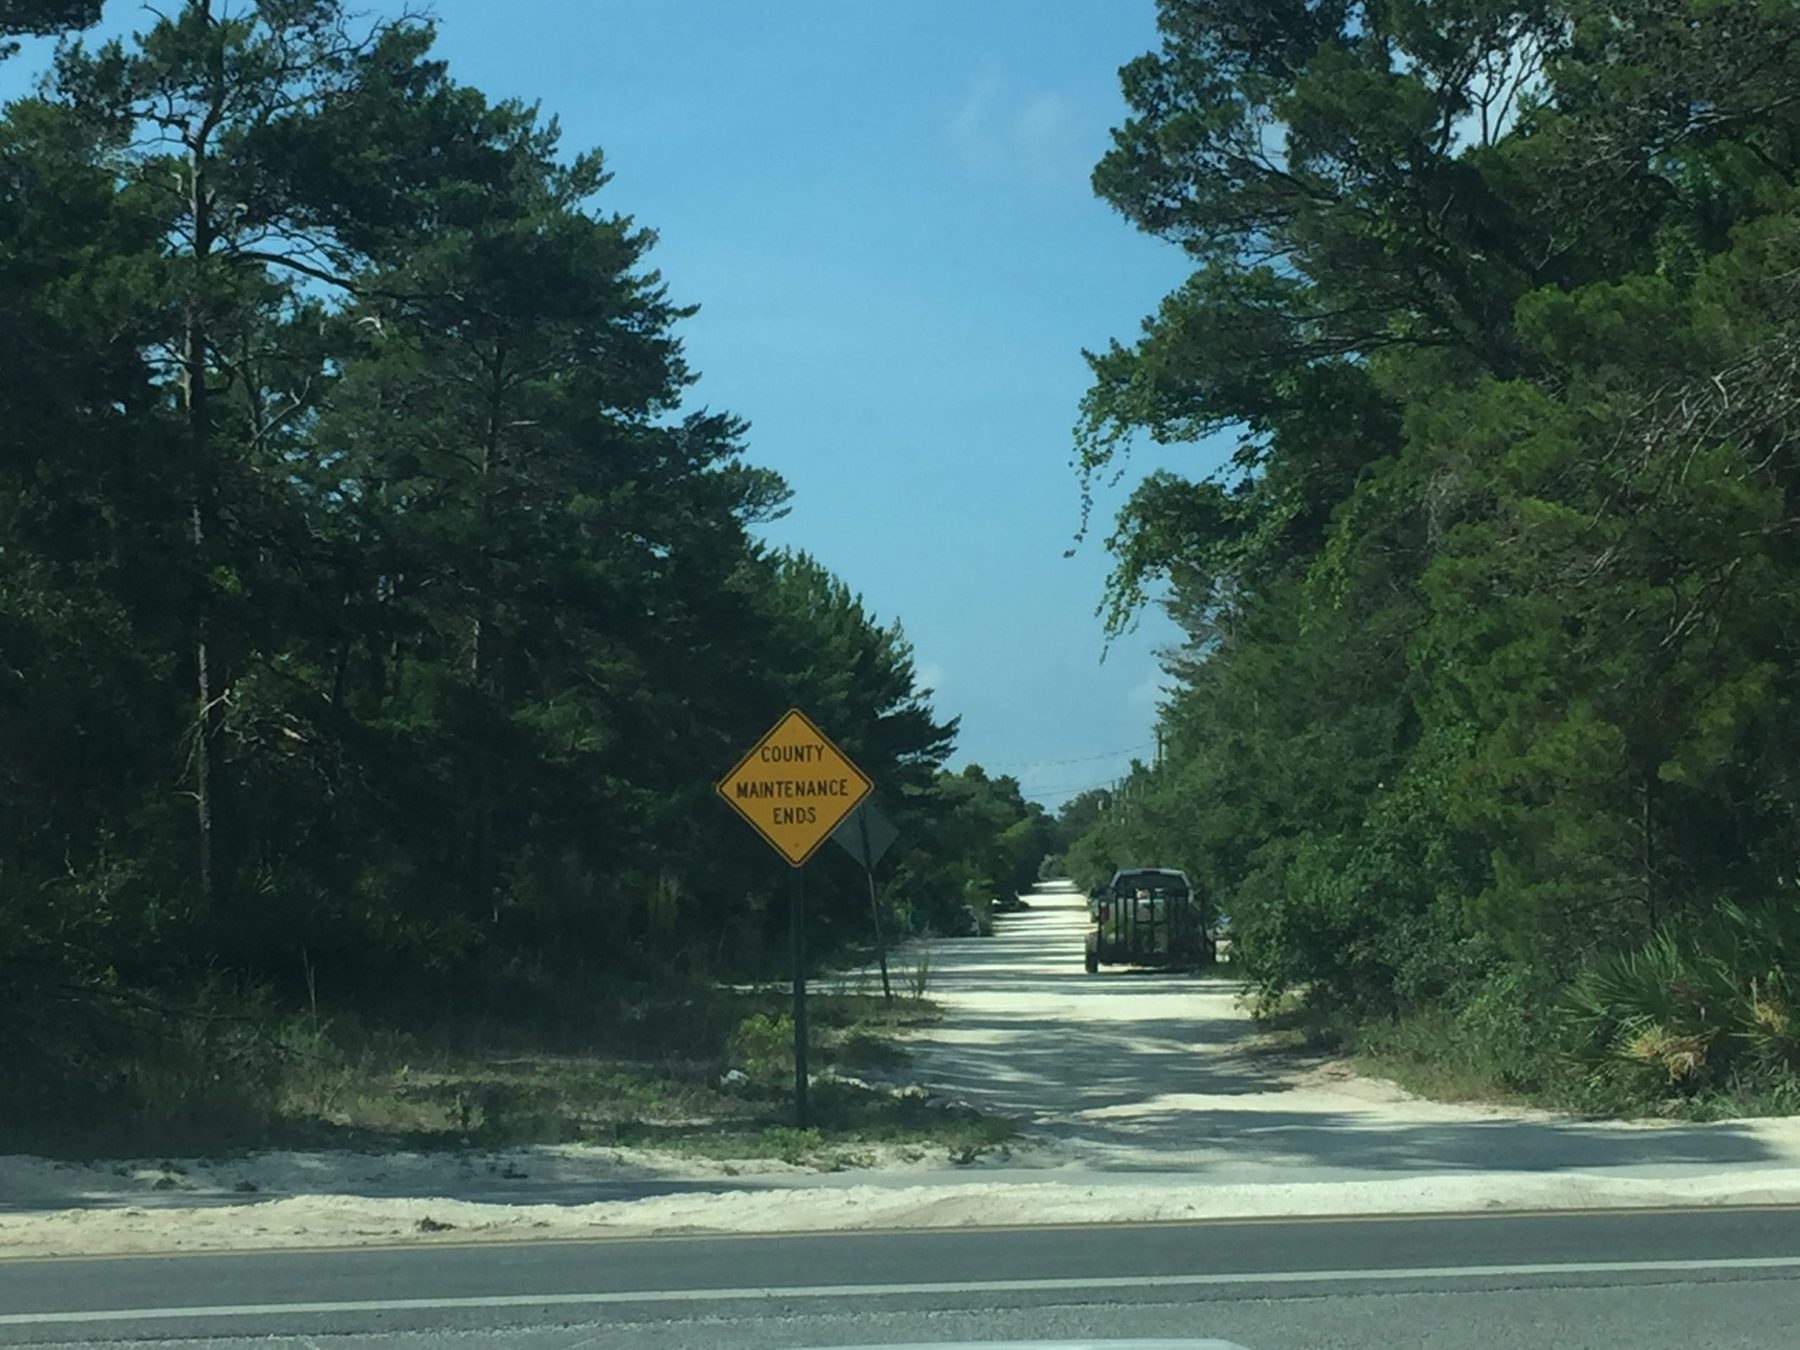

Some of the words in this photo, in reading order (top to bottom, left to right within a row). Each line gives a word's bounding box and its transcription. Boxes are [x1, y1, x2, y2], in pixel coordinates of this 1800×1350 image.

[761, 745, 824, 763] COUNTY
[736, 779, 848, 798] MAINTENANCE
[773, 807, 816, 825] ENDS
